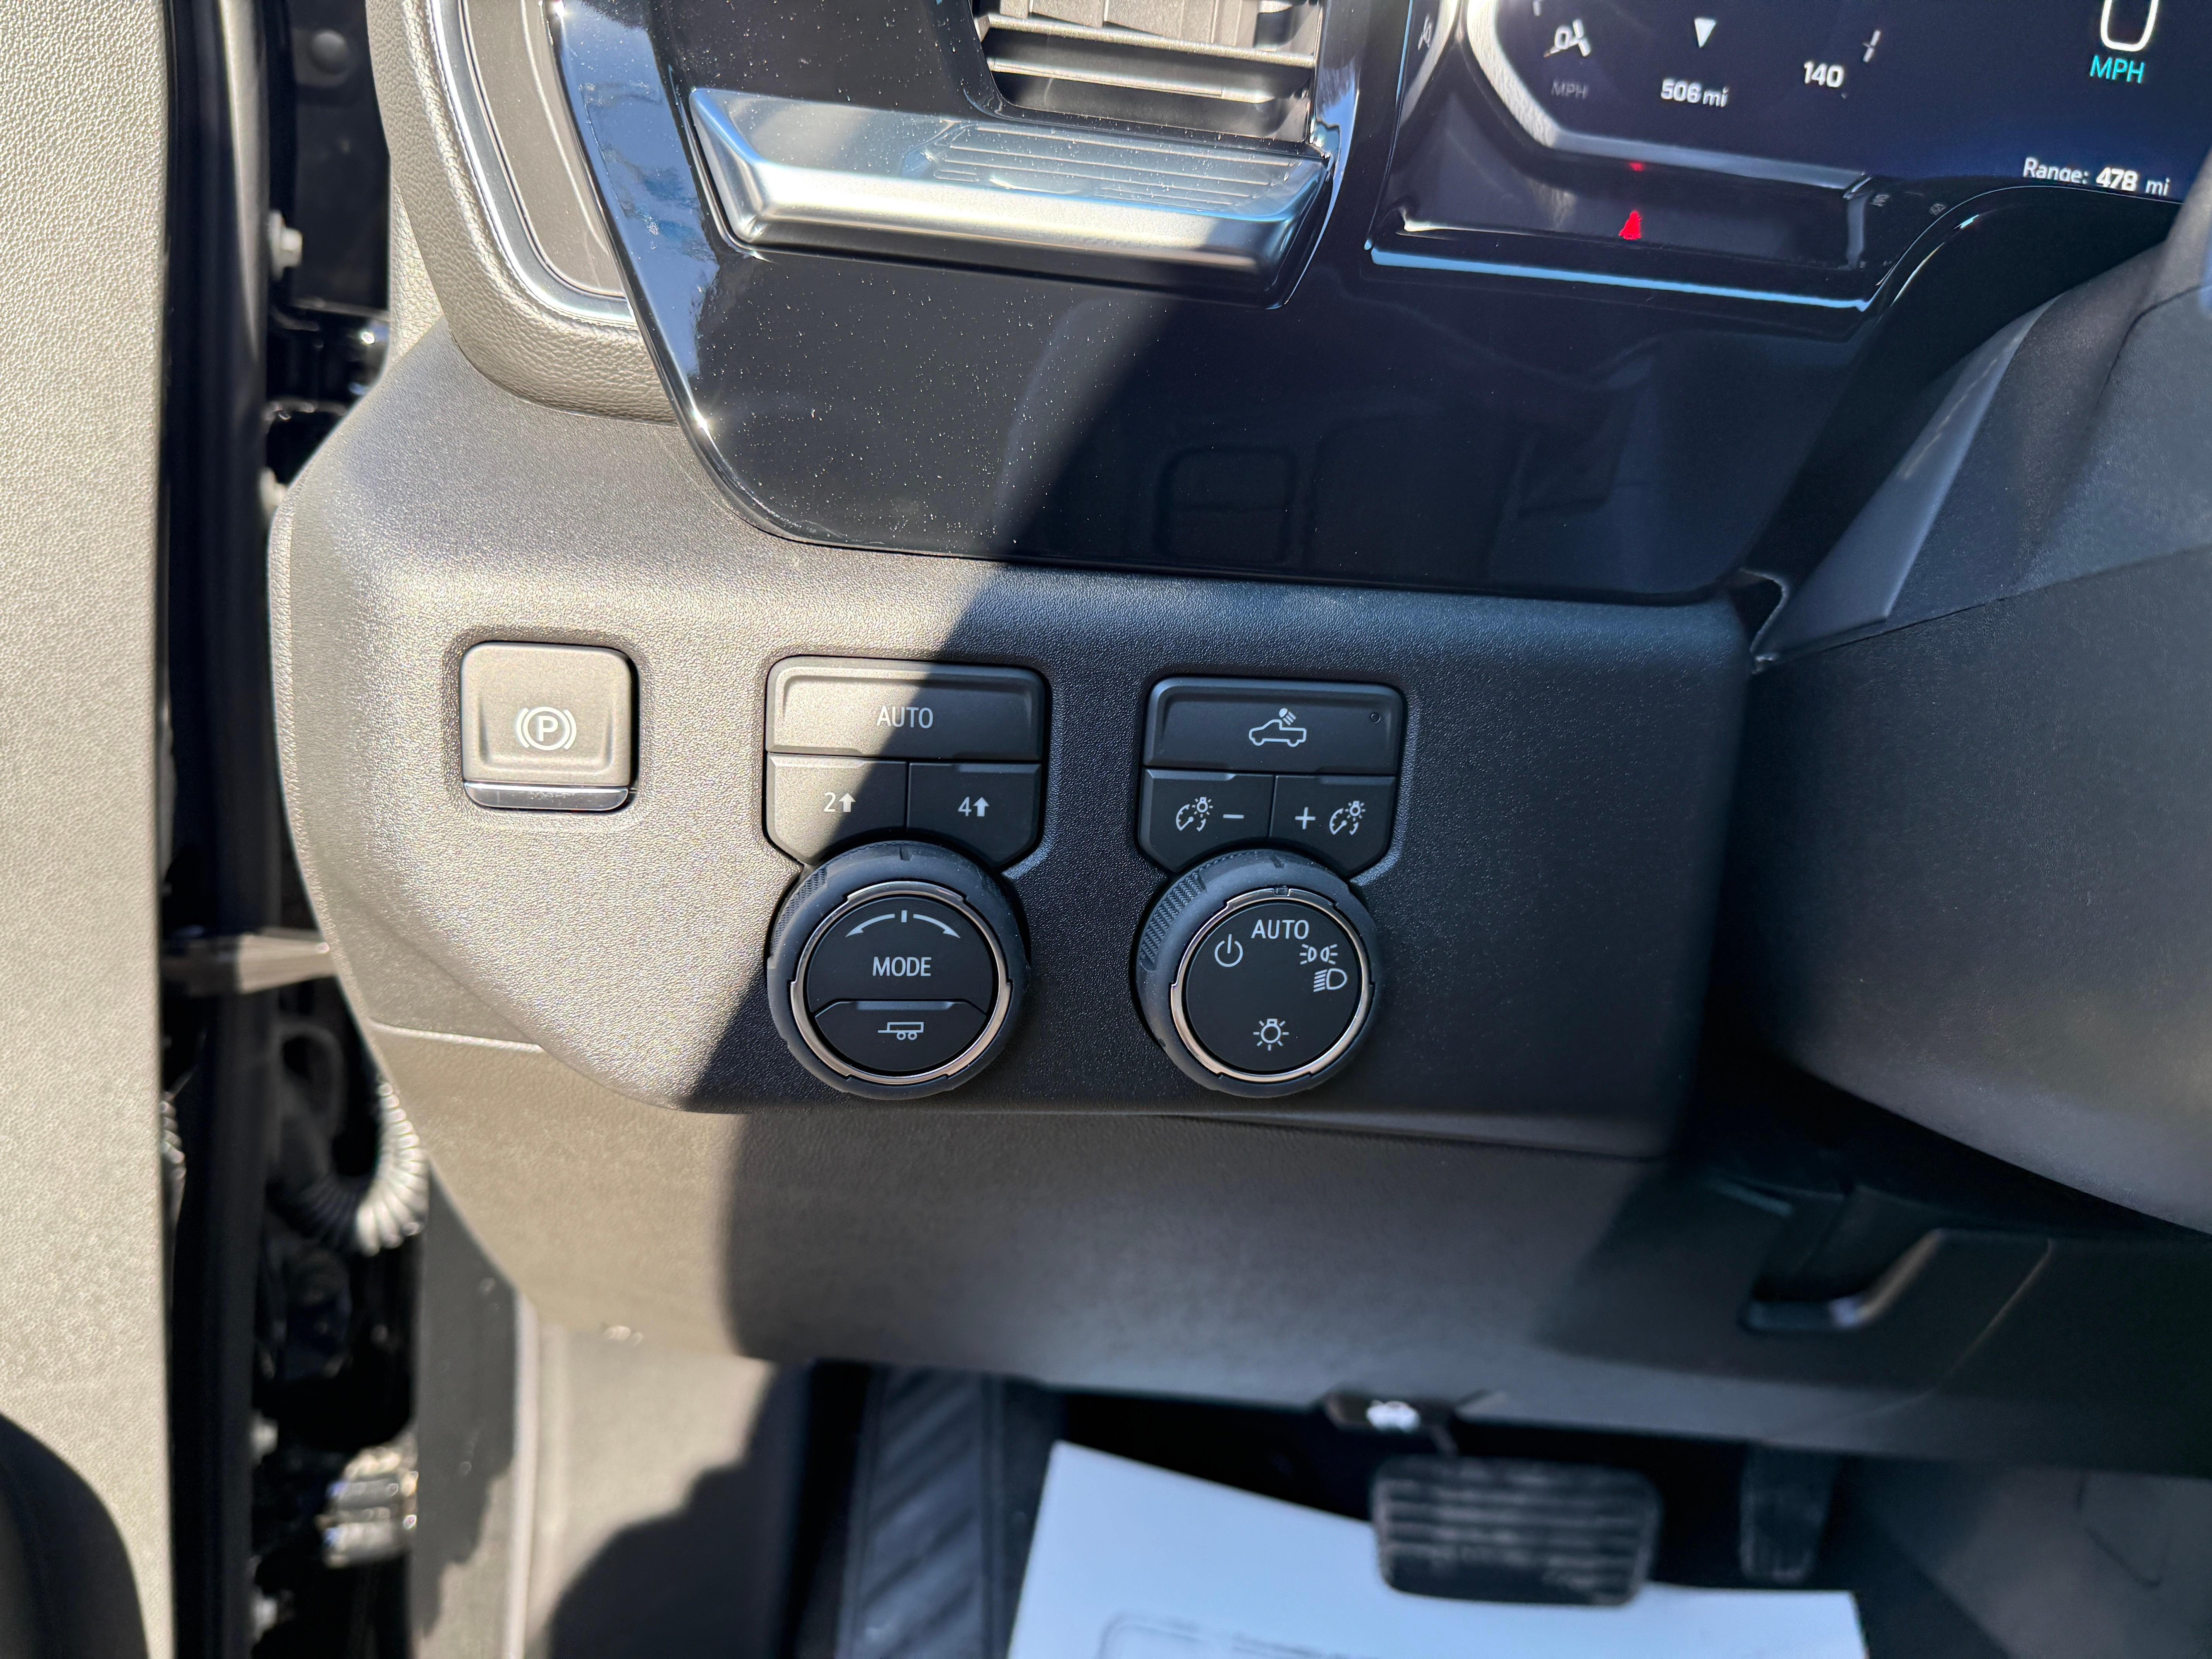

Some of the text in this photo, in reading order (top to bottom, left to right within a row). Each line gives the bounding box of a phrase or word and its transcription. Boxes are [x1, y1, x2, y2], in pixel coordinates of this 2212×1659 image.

[1804, 61, 1844, 88] 140
[2090, 55, 2145, 84] MPH
[1551, 79, 1589, 99] MPH
[1661, 79, 1729, 107] 506 mi
[2023, 156, 2170, 196] Range: 478 mi
[538, 716, 559, 742] P
[876, 706, 934, 729] AUTO
[823, 792, 837, 813] 2
[957, 796, 971, 817] 4
[1251, 919, 1310, 941] AUTO
[872, 957, 932, 977] MODE
